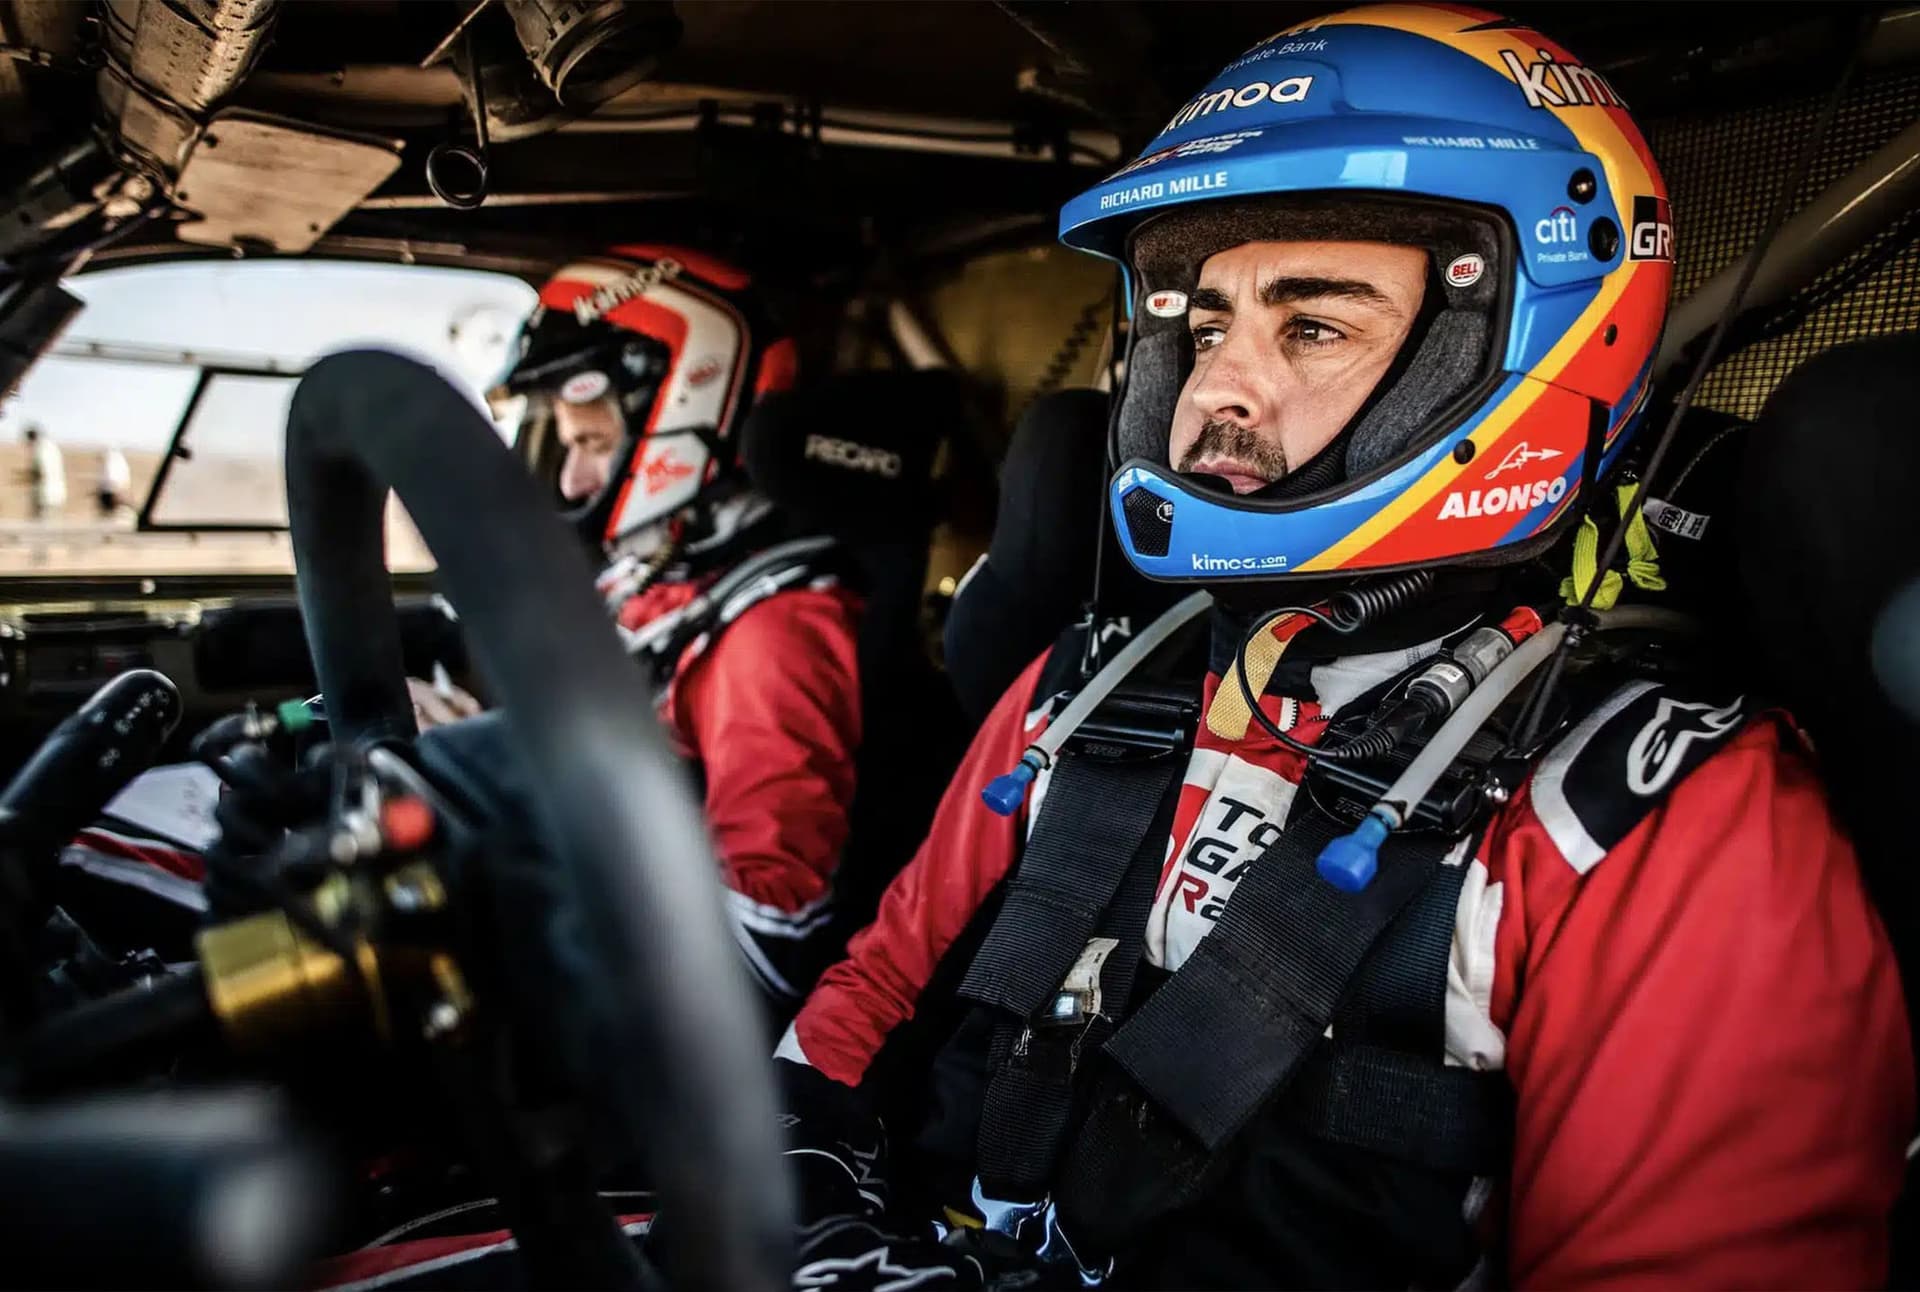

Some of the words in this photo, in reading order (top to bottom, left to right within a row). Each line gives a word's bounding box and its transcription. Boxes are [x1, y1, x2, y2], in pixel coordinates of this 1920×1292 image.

[1279, 38, 1328, 55] Bank
[1500, 50, 1631, 111] kim
[1157, 75, 1314, 139] kimoa
[1487, 137, 1540, 150] MILLE
[1100, 182, 1164, 210] RICHARD
[1169, 171, 1229, 195] MILLE
[1535, 210, 1577, 244] citi
[1633, 221, 1671, 258] GR
[1452, 262, 1478, 277] BELL
[1537, 252, 1567, 263] Private
[1568, 251, 1588, 262] Bank
[1436, 476, 1567, 520] ALONSO
